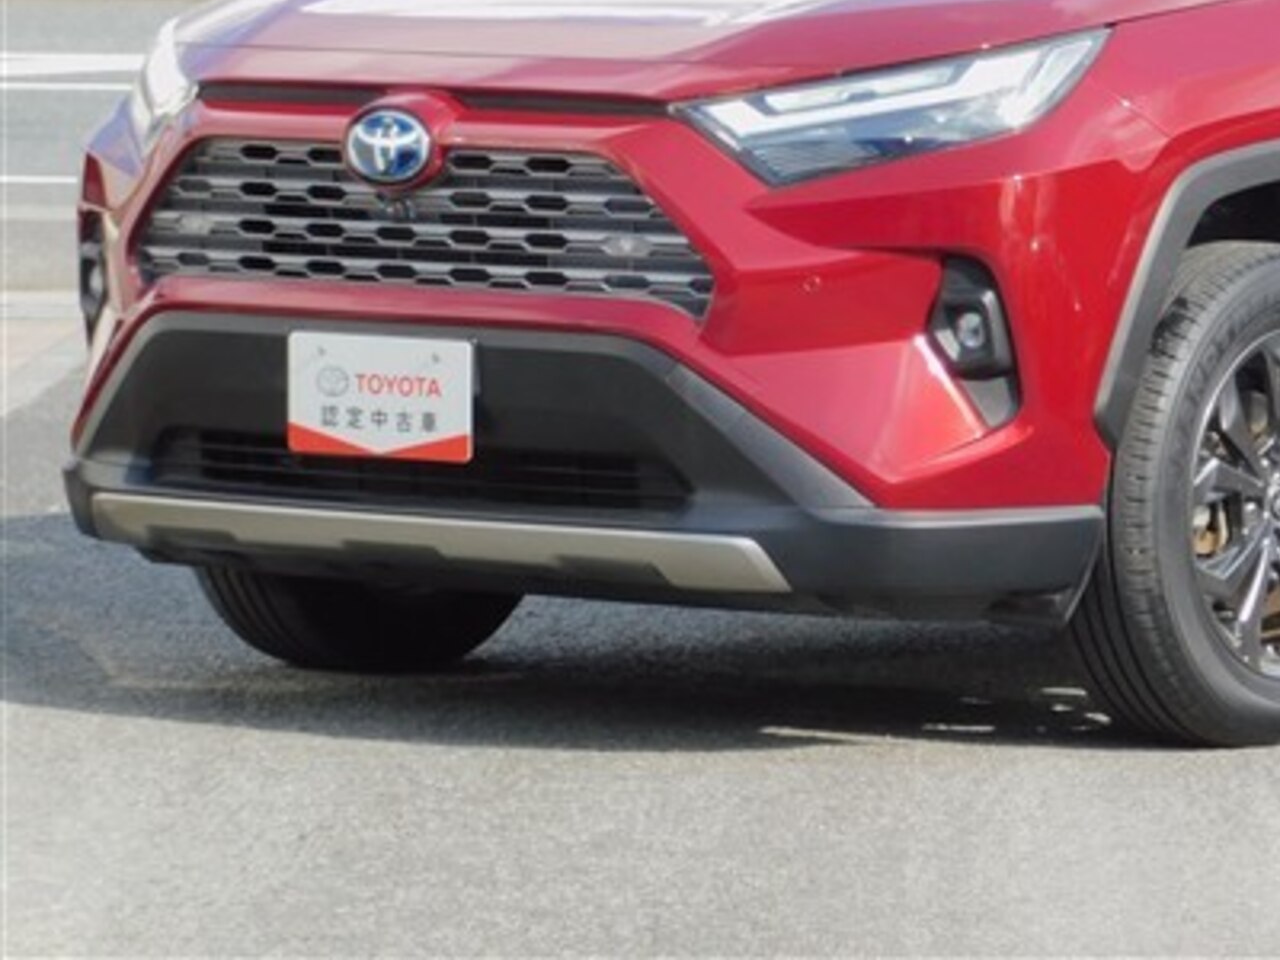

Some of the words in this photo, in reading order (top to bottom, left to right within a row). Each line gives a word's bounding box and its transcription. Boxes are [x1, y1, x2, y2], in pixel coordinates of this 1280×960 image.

[354, 373, 442, 398] TOYOTA
[321, 405, 437, 432] 認定中古車
